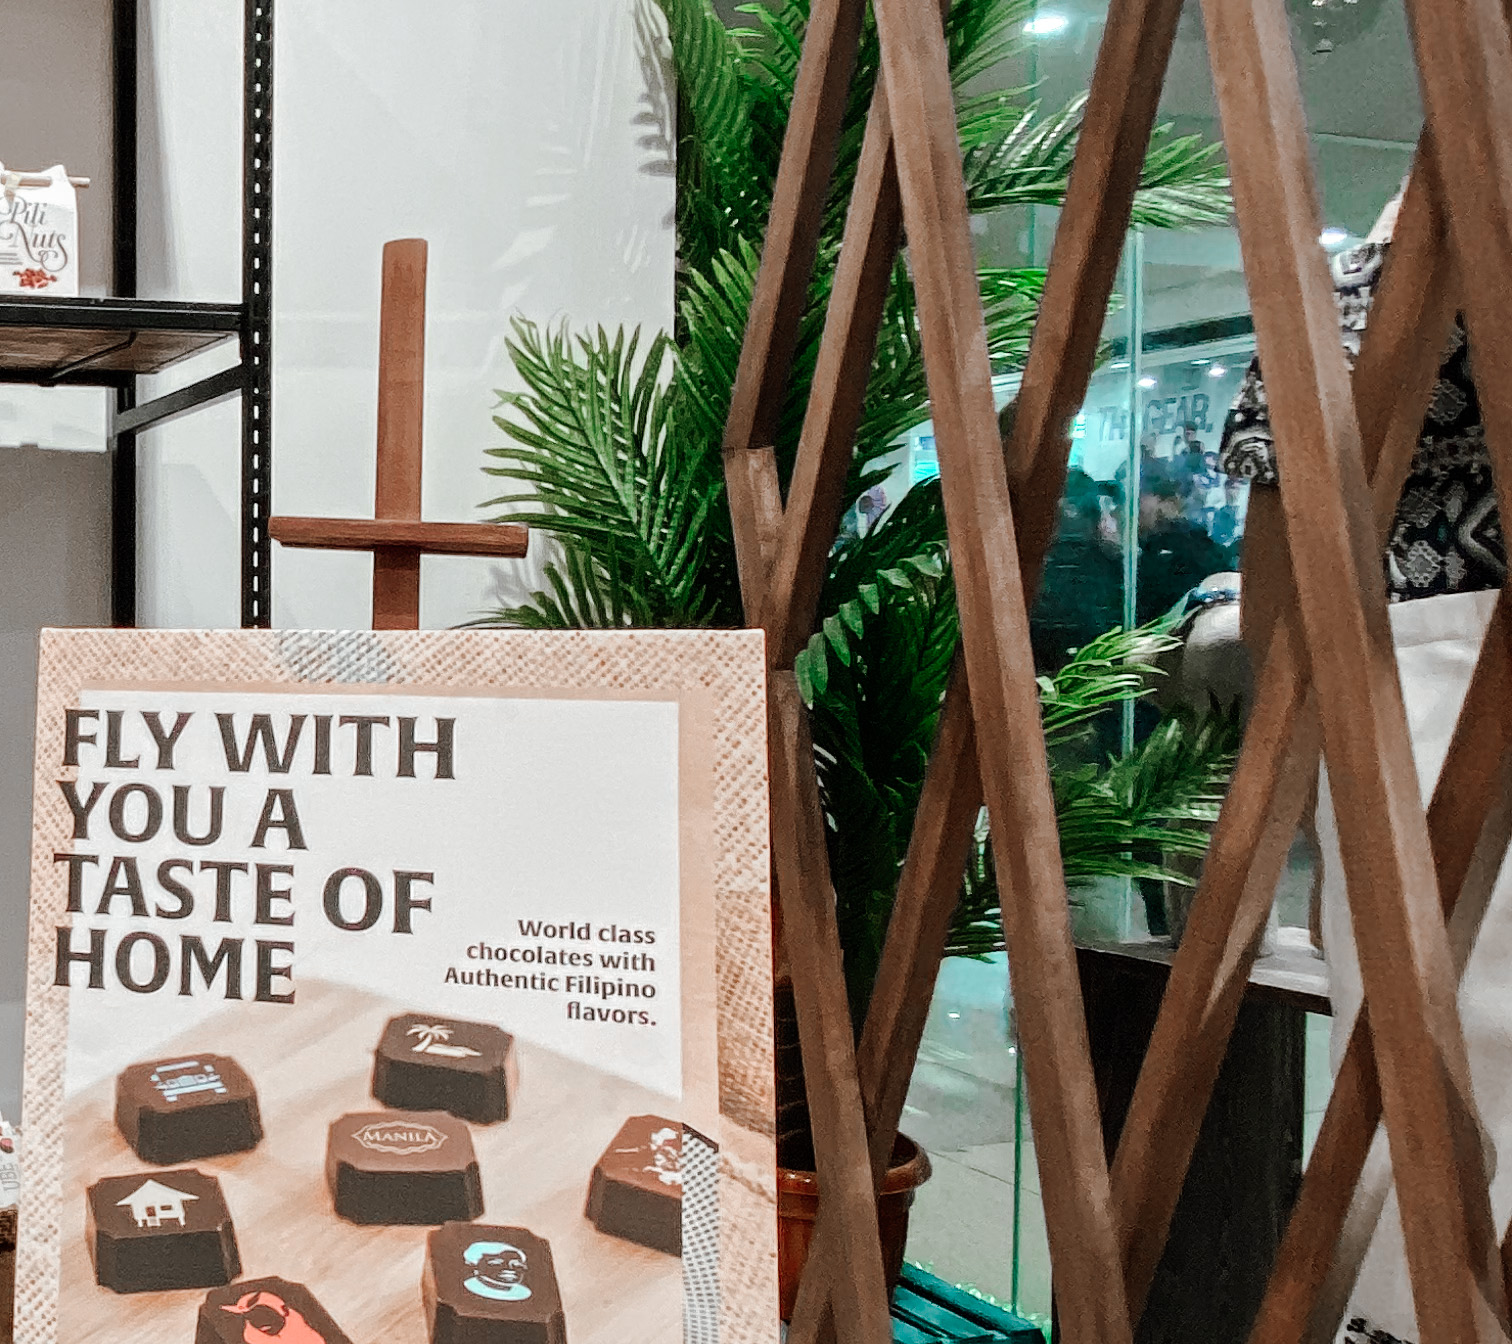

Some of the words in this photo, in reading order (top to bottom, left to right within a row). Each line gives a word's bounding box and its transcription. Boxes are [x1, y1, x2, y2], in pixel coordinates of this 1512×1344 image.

[62, 708, 195, 770] FLY
[214, 711, 457, 780] WITH
[57, 780, 226, 846] YOU
[249, 788, 309, 851] A
[53, 853, 296, 927] TASTE
[322, 866, 435, 935] OF
[518, 919, 591, 941] World
[598, 924, 656, 945] class
[53, 926, 296, 1005] HOME
[466, 942, 594, 967] chocolates
[599, 951, 656, 972] with
[444, 966, 560, 992] Authentic
[565, 975, 657, 1000] Filipino
[567, 1001, 657, 1027] flavors.
[363, 1131, 437, 1142] MANILA
